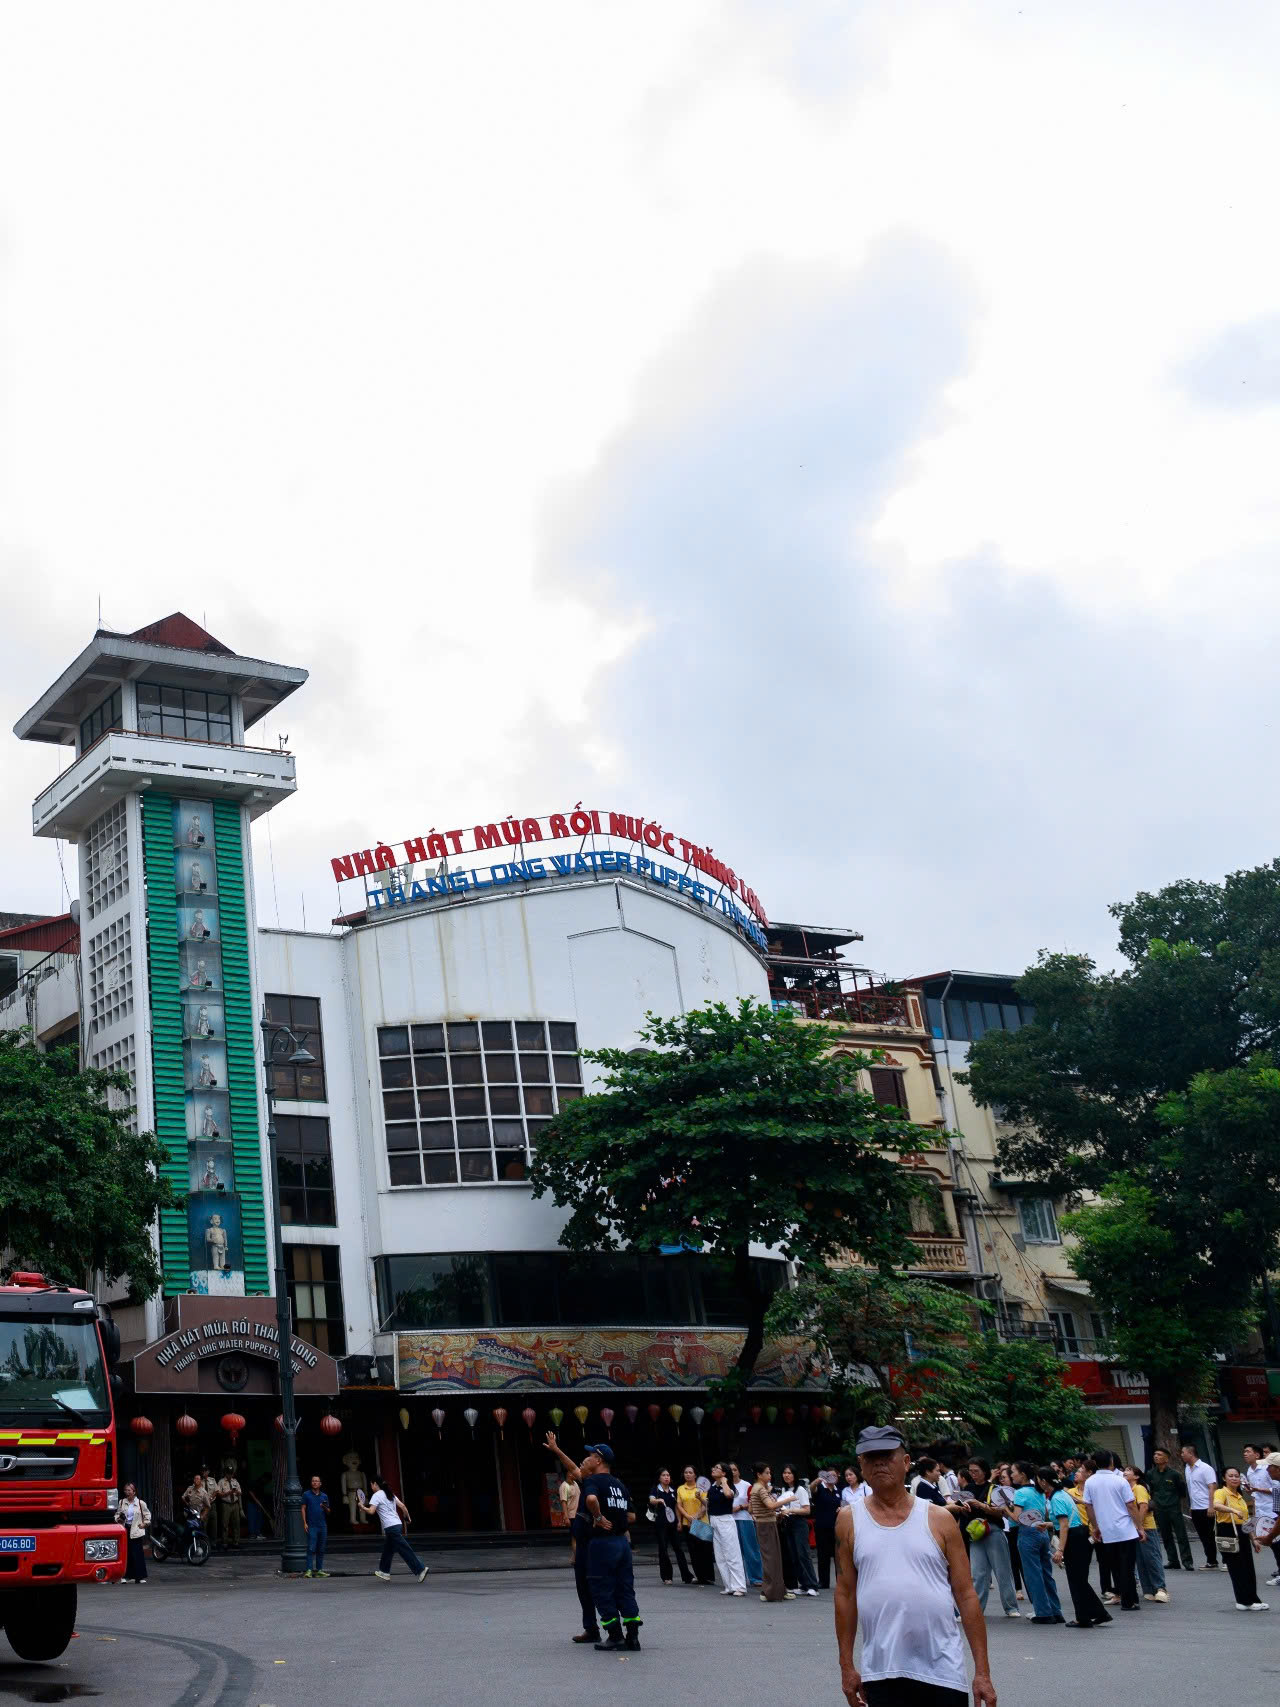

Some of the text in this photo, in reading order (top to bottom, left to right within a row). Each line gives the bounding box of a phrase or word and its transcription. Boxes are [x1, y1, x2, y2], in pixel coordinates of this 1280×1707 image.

[331, 801, 769, 929] NHÀ HÁT MÚA RỐI NƯỚC THĂNG LONG
[368, 871, 469, 910] THANG
[472, 858, 548, 888] LONG
[549, 851, 632, 875] WATER
[636, 856, 717, 906] PUPPET
[157, 1341, 181, 1366] NHÀ
[180, 1328, 200, 1349] HÁT
[202, 1320, 229, 1338] MÚA
[232, 1317, 250, 1335] RỐI
[290, 1339, 318, 1367] LONG
[174, 1353, 197, 1373] THANG
[198, 1344, 217, 1356] LONG
[219, 1340, 243, 1351] WATER
[245, 1341, 273, 1355] PUPPET
[610, 1486, 622, 1497] 114
